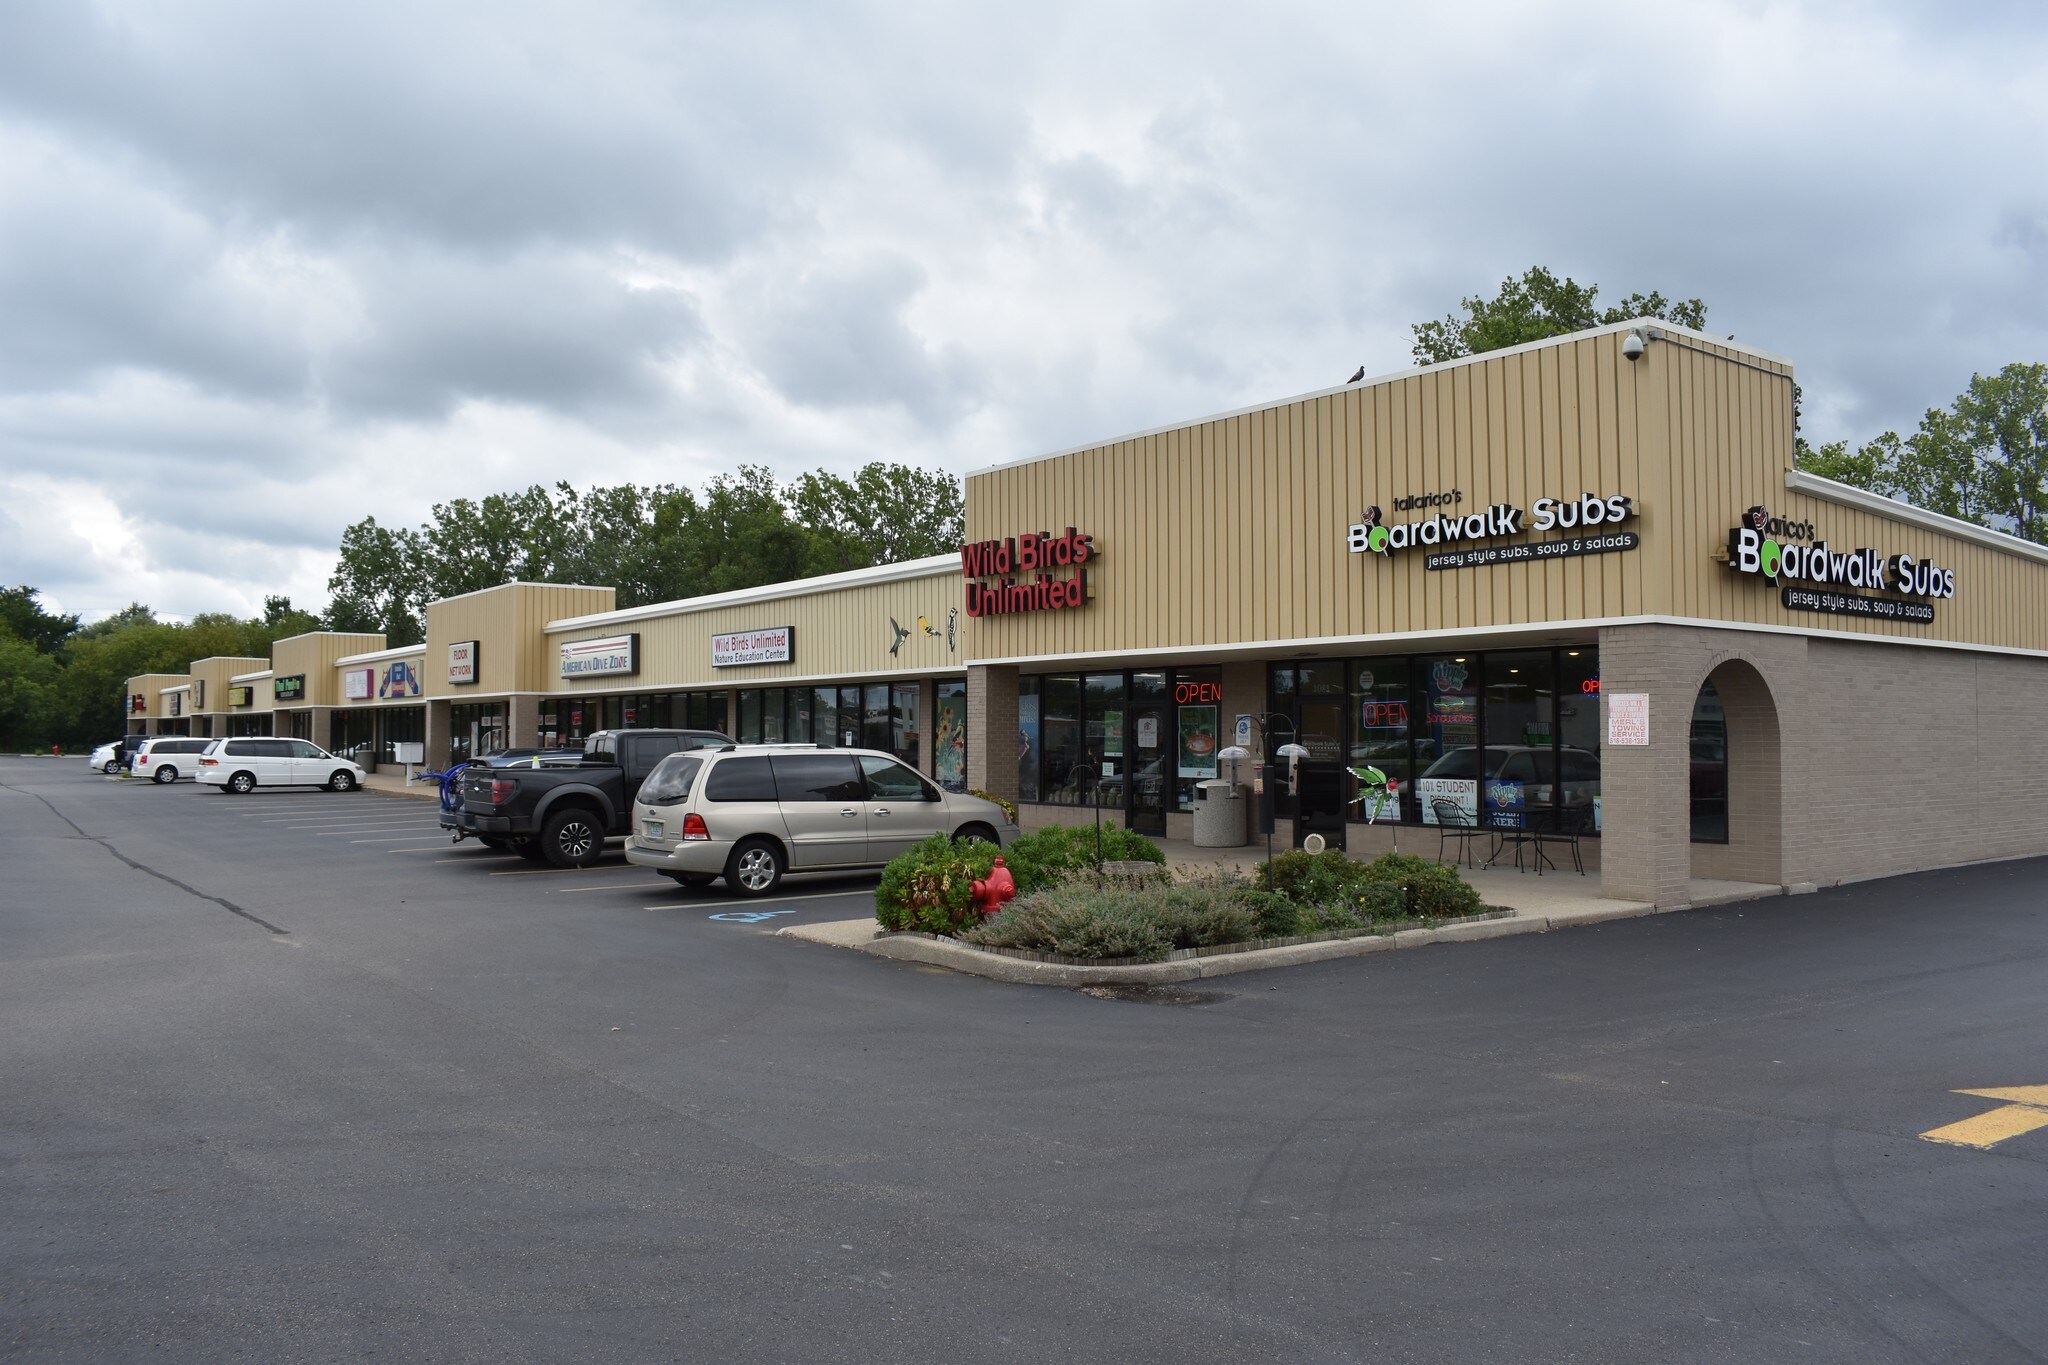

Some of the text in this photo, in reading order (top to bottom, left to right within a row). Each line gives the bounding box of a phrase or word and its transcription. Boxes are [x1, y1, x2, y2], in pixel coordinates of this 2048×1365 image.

[1393, 489, 1462, 512] tallarico's
[1347, 492, 1628, 553] Boardwalk Subs
[960, 527, 1092, 578] Wild Birds
[1428, 534, 1632, 570] jersey style subs, soup & salads
[1738, 528, 1955, 599] Boardwalk Subs
[965, 568, 1087, 617] Unlimited
[1788, 589, 1932, 619] jersey style subs, soup & salads
[714, 630, 786, 653] Wild Birds Unlimited
[453, 649, 468, 660] FLOOR
[562, 660, 592, 673] AMERICAN
[609, 655, 628, 669] ZONE
[714, 649, 786, 664] Nature Education Center
[449, 665, 471, 676] NETWORK
[1175, 683, 1222, 703] OPEN
[1582, 680, 1600, 693] OP
[1422, 780, 1475, 793] 10% STUDENT
